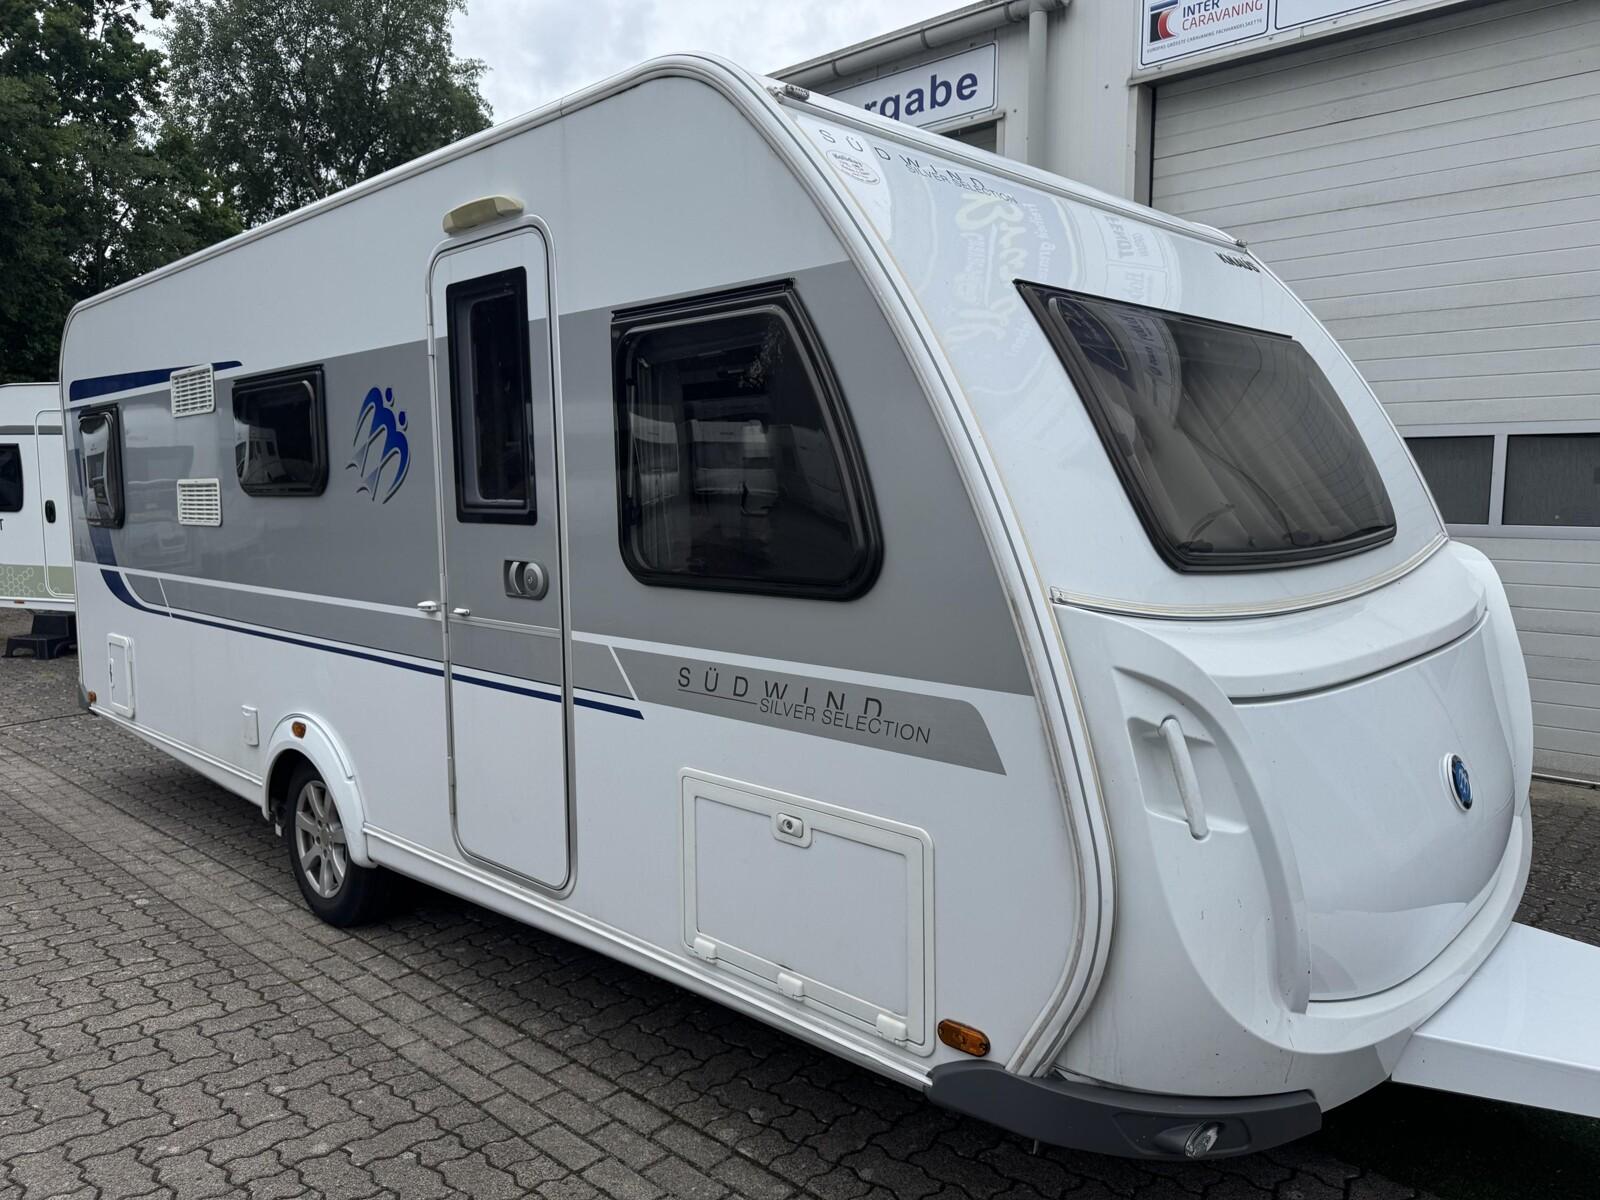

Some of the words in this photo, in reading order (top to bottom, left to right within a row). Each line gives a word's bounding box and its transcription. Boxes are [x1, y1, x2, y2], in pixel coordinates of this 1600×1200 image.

[1182, 0, 1220, 18] INTER
[1182, 0, 1264, 31] CARAVANING
[677, 666, 883, 718] SÜDWIND
[759, 698, 816, 722] SILVER
[821, 708, 931, 745] SELECTION
